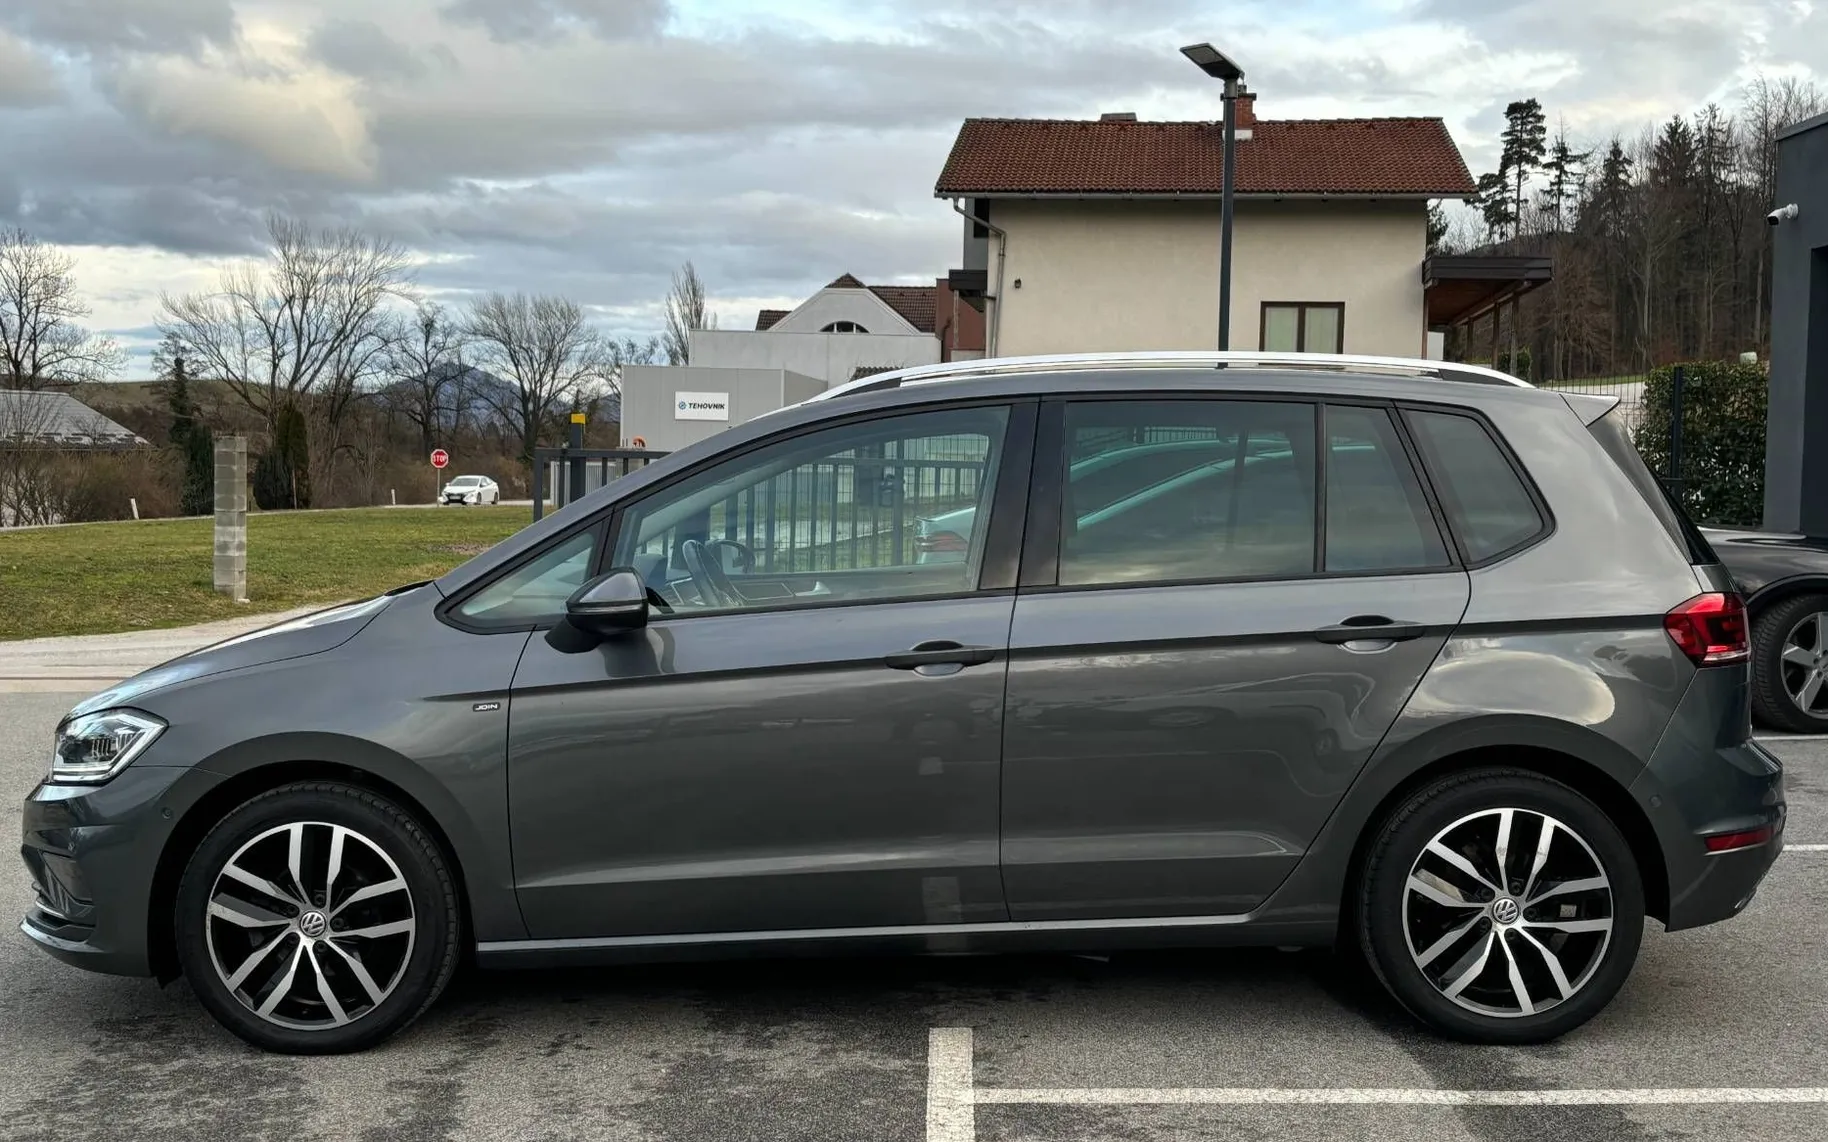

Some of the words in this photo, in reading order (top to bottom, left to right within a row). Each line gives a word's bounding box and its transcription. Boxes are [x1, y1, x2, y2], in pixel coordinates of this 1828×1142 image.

[688, 402, 726, 410] TEHOVNIK
[432, 454, 447, 463] STOP
[474, 703, 498, 711] JOIN
